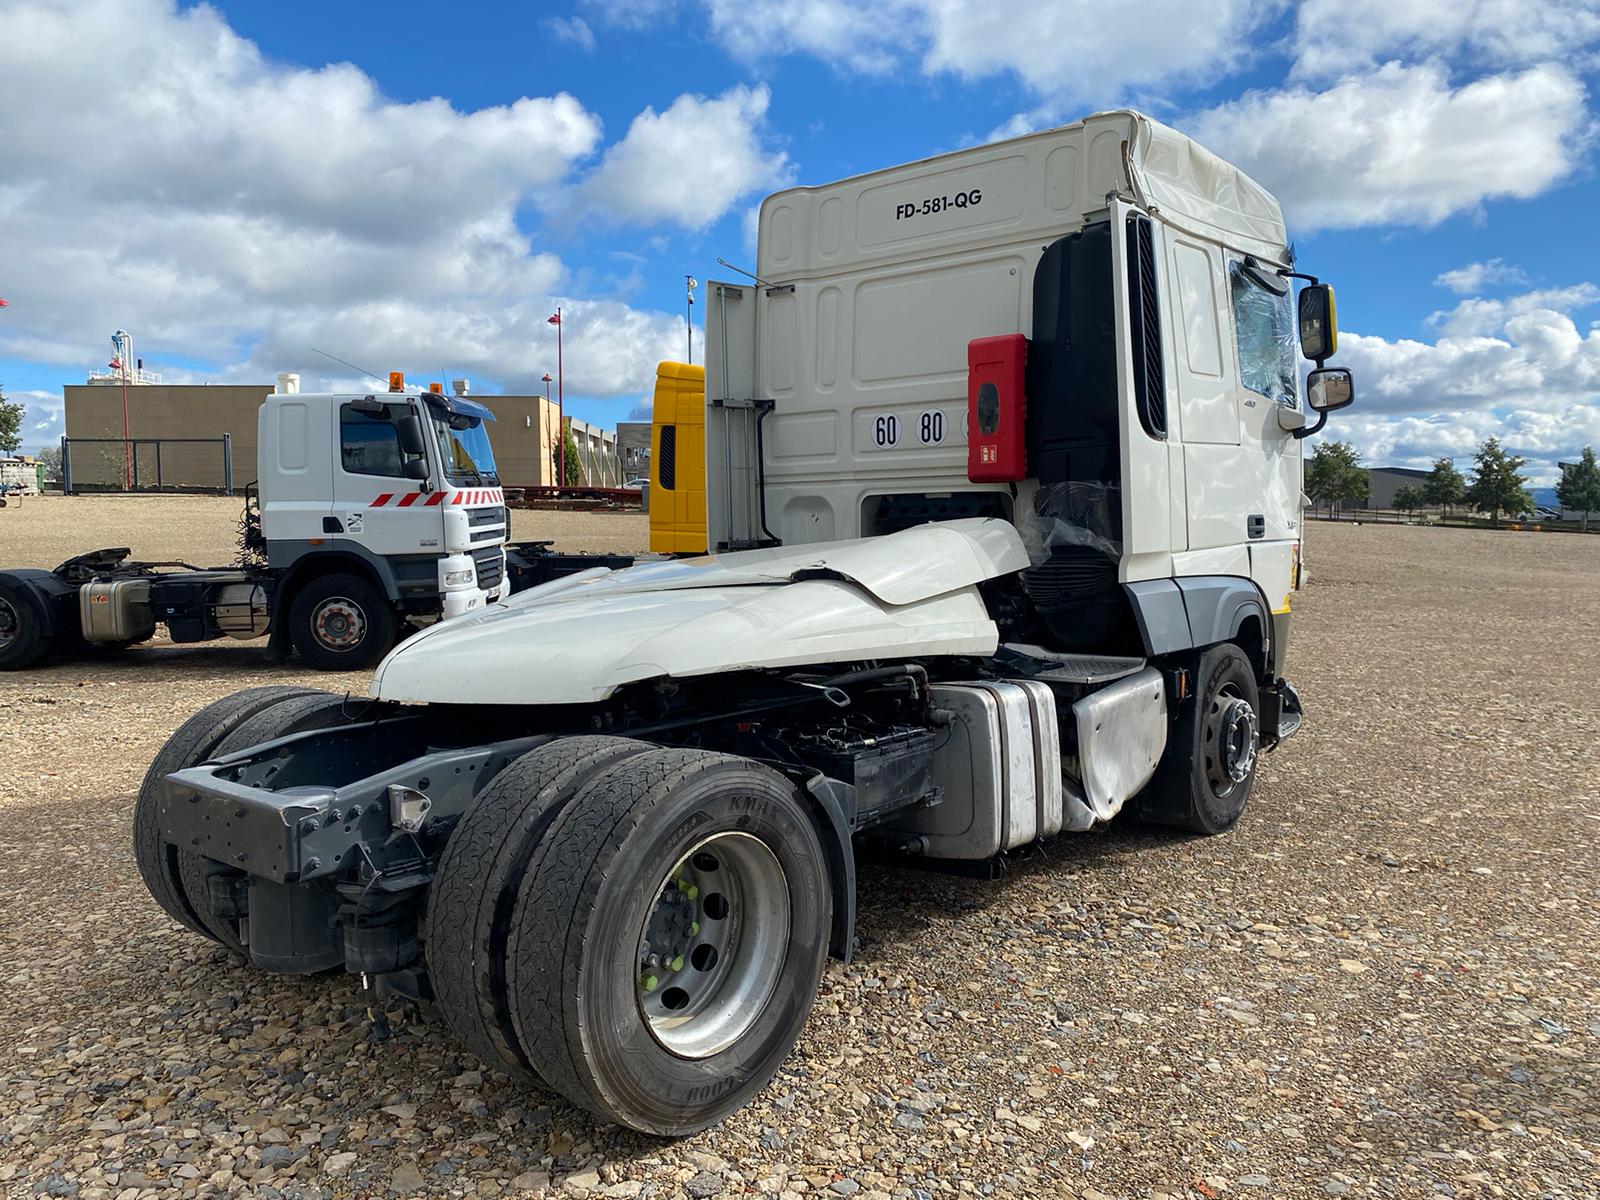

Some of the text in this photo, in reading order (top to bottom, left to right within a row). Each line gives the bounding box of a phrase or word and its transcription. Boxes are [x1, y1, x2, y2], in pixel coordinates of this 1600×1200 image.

[896, 189, 982, 220] FD-581-QG
[876, 412, 943, 446] 60 80
